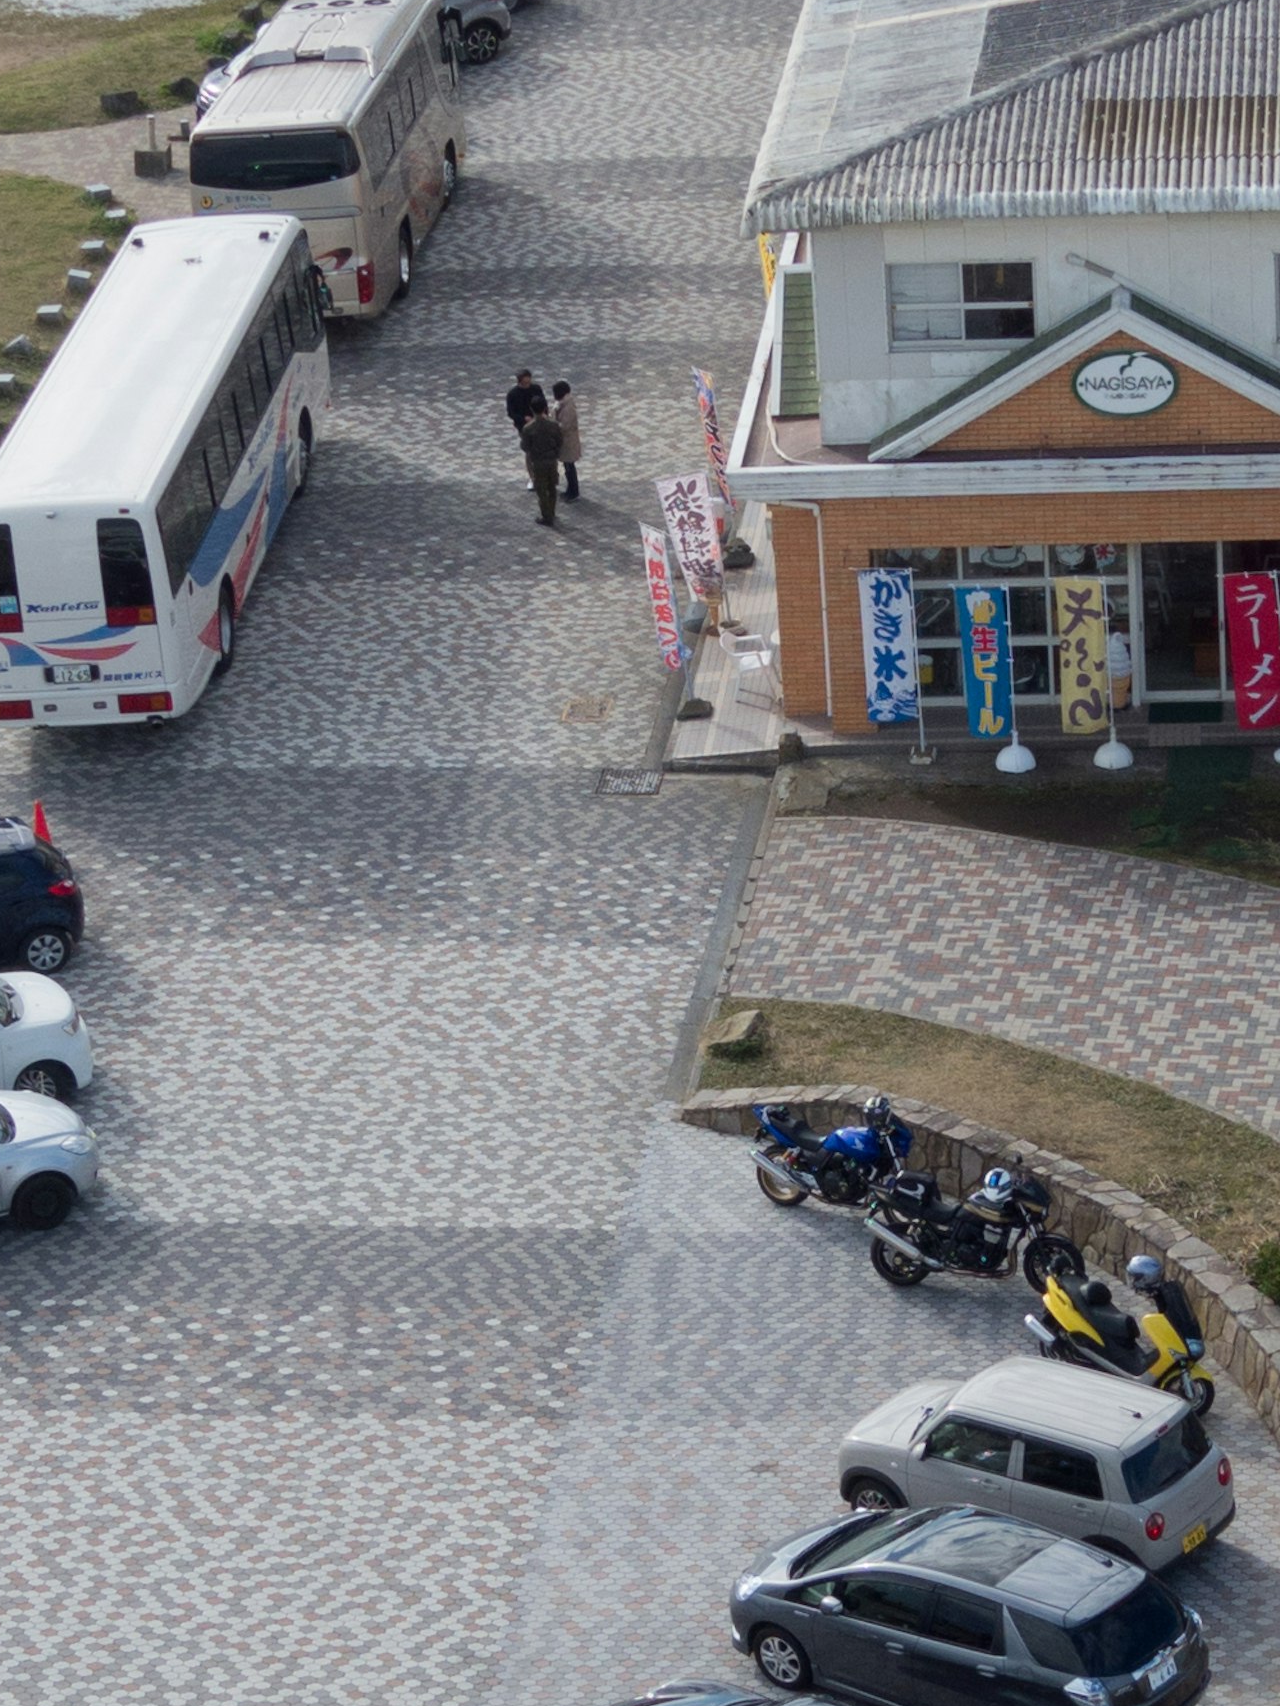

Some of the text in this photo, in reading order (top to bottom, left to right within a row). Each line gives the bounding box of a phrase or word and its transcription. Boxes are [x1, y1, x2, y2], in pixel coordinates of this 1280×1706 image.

[1085, 376, 1168, 391] NAGISAYA
[870, 577, 908, 682] かき氷
[971, 626, 1005, 735] 生ビール
[1236, 584, 1278, 725] ラーメン
